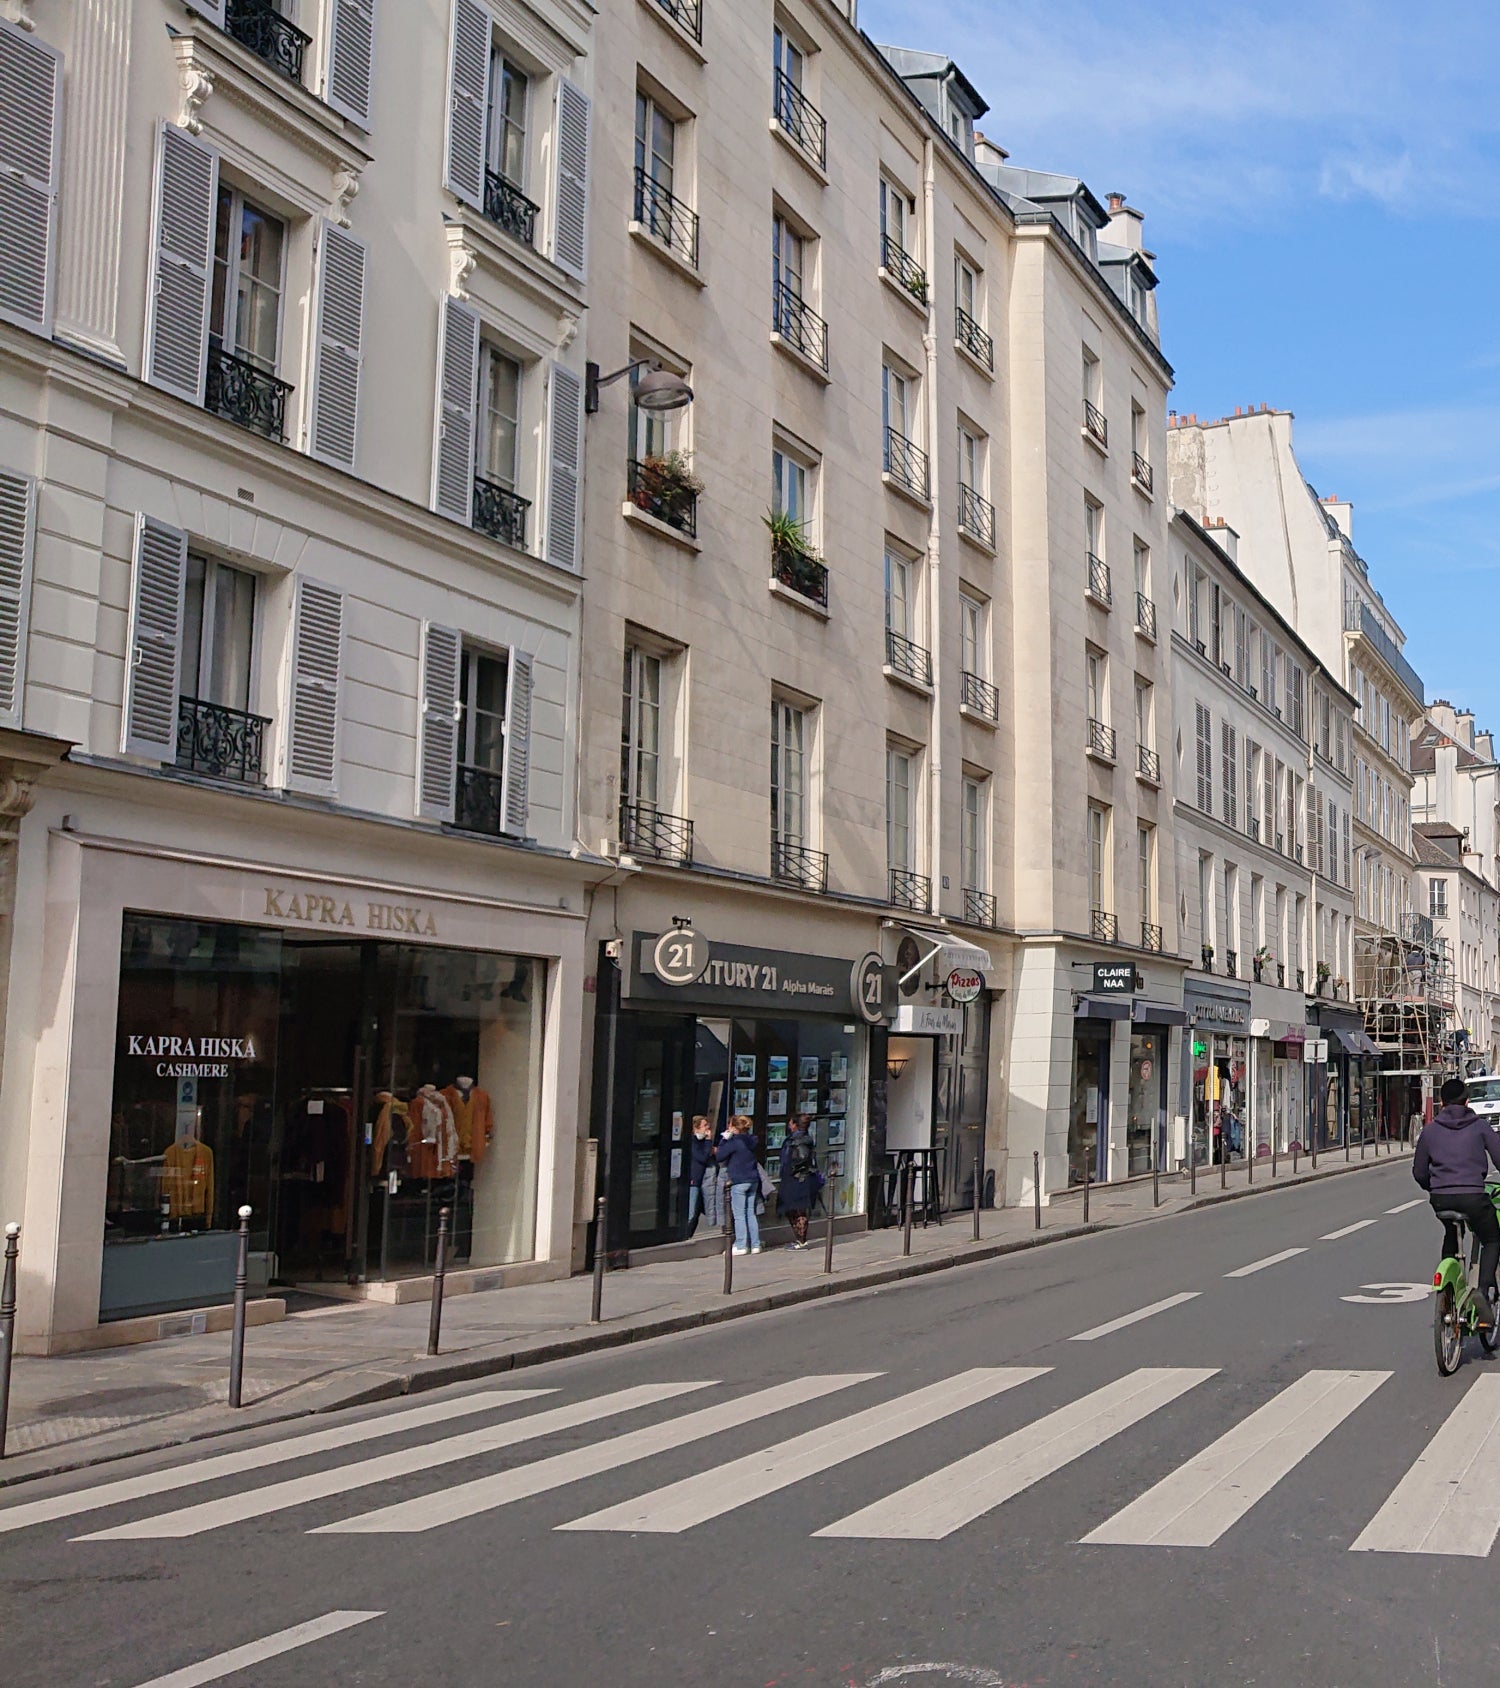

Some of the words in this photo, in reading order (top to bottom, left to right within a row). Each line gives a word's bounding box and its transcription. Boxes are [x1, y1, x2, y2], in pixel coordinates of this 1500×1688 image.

[263, 888, 355, 926] KAPRA
[366, 902, 438, 936] HISKA
[688, 960, 760, 989] NTURY
[761, 966, 777, 991] 21
[782, 980, 806, 996] Alpha
[807, 982, 834, 996] Marais
[951, 972, 980, 988] Pizzas
[1097, 968, 1131, 977] CLAIRE
[1103, 979, 1125, 988] NAA
[128, 1035, 196, 1056] KAPRA
[198, 1037, 256, 1058] HISKA
[156, 1062, 229, 1078] CASHMERE
